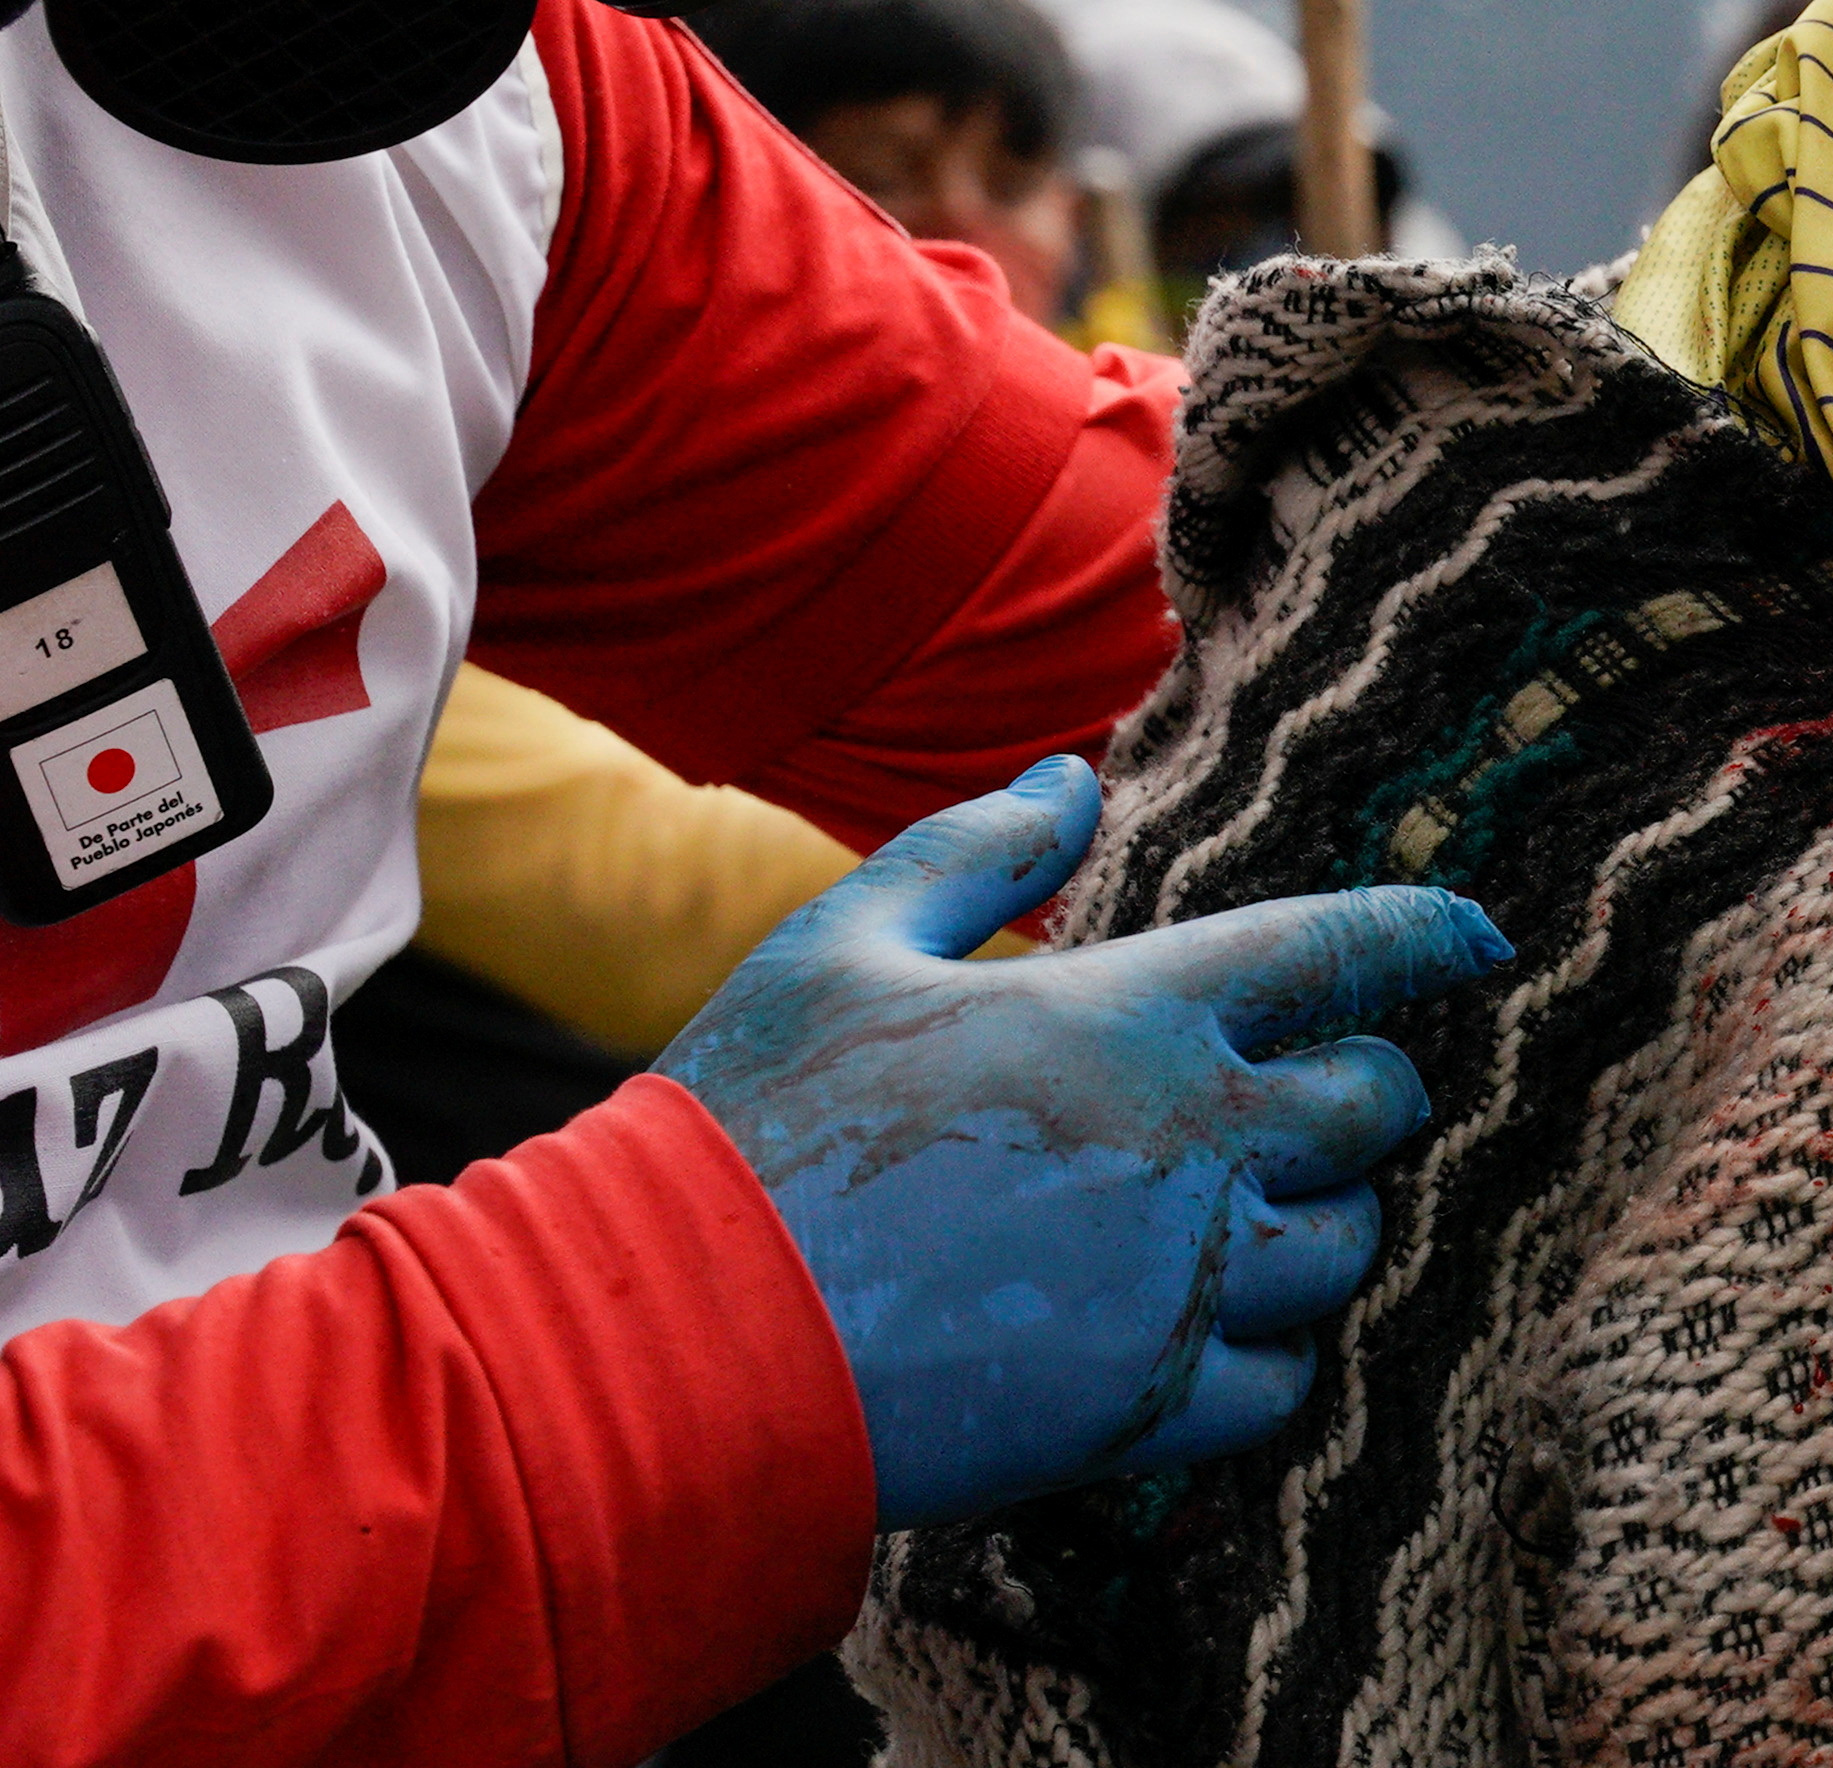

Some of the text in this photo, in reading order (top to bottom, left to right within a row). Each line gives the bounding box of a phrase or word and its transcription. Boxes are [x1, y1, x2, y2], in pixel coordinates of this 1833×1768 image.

[70, 802, 204, 871] Pueblo Japonés
[79, 791, 185, 850] De Parte del
